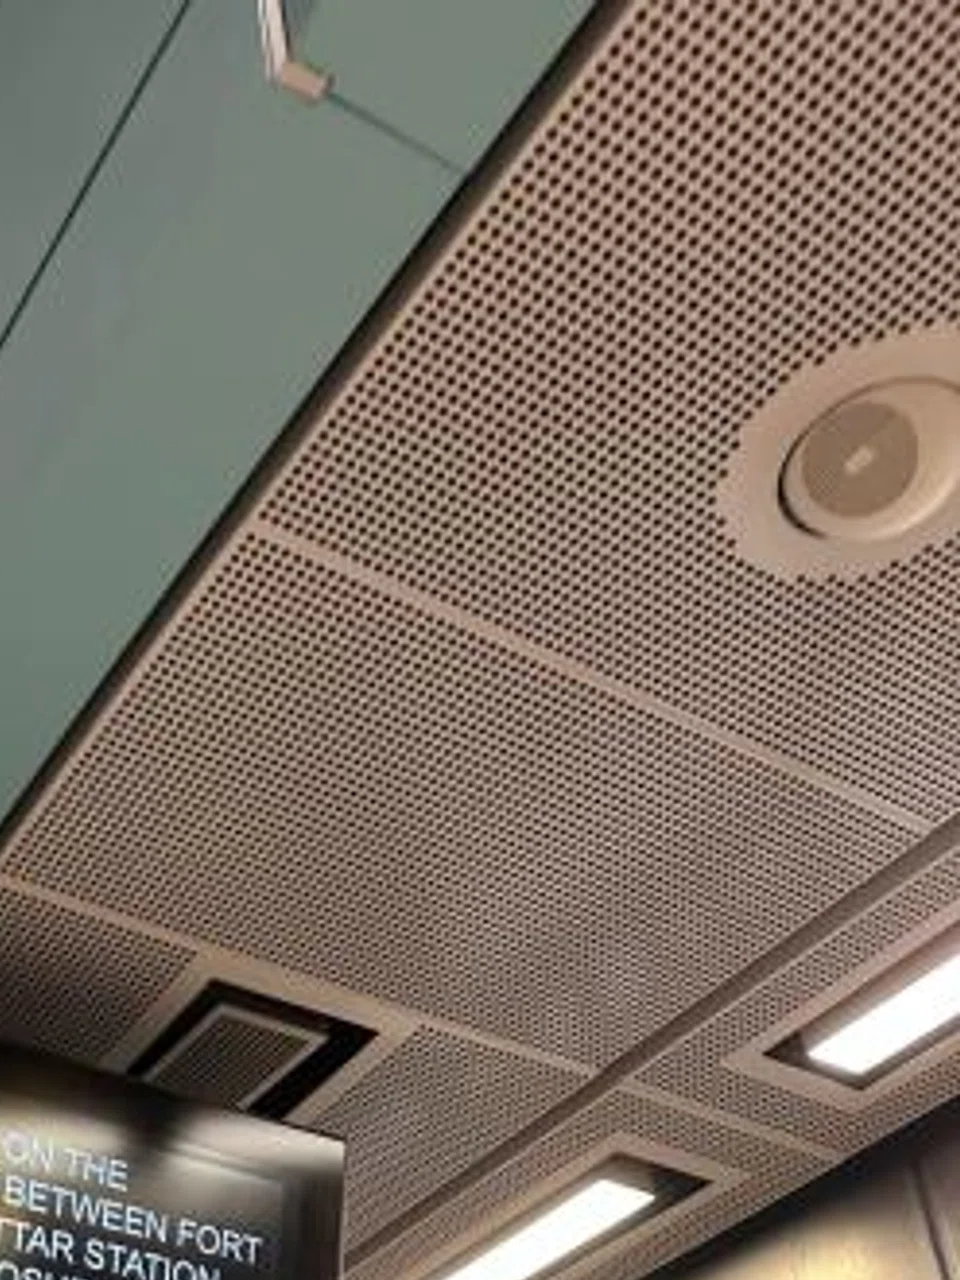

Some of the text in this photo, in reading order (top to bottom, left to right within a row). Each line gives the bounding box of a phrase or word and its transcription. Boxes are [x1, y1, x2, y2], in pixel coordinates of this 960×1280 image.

[1, 1132, 55, 1172] ON
[64, 1148, 128, 1192] THE
[5, 1179, 167, 1244] BETWEEN
[177, 1219, 263, 1264] FORT
